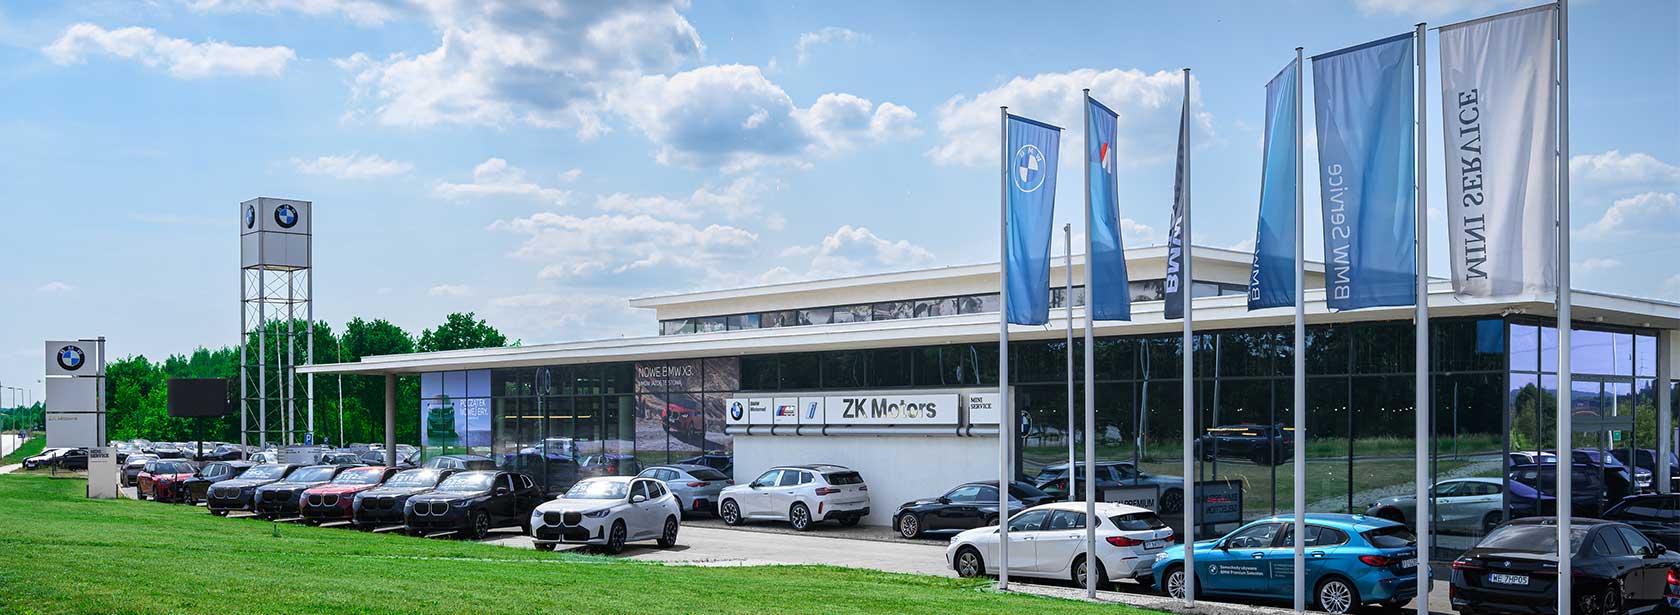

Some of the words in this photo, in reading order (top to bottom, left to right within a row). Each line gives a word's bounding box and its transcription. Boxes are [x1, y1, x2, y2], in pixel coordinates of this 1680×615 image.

[639, 366, 661, 377] NOWE
[662, 366, 681, 377] BMW
[842, 398, 867, 418] ZK
[871, 398, 937, 418] Motors
